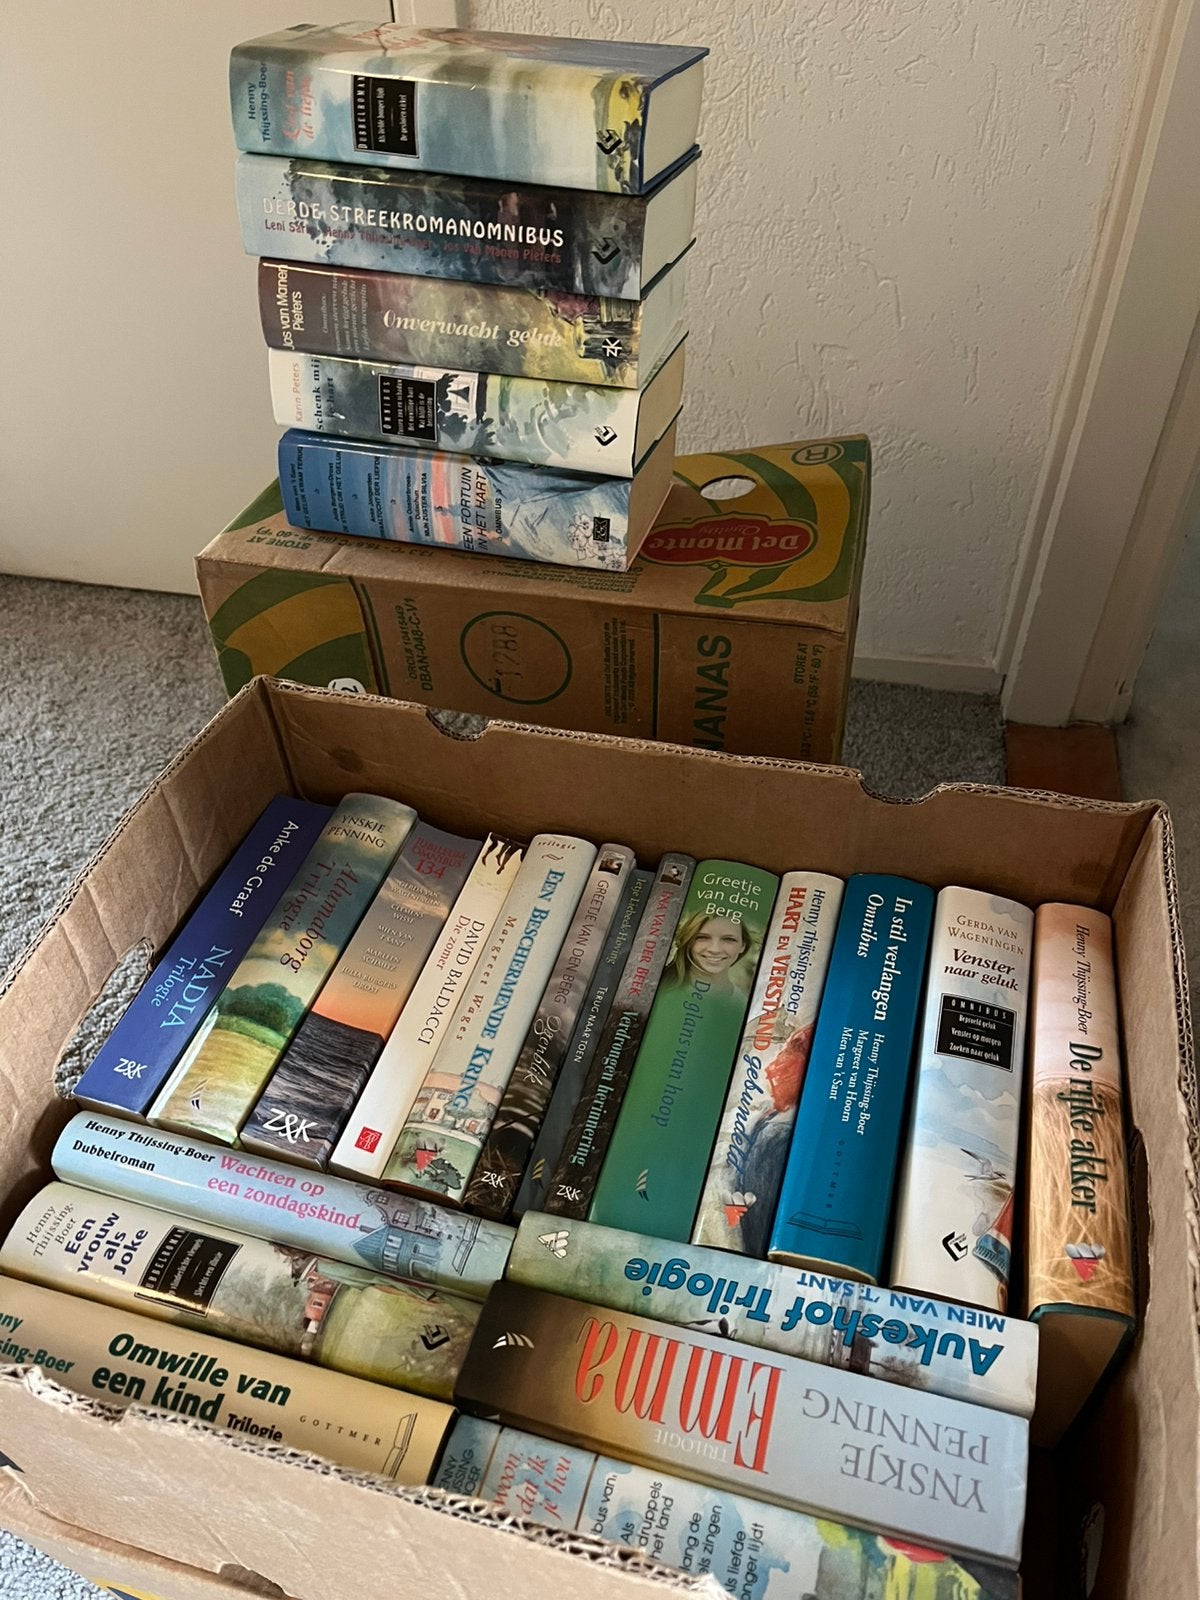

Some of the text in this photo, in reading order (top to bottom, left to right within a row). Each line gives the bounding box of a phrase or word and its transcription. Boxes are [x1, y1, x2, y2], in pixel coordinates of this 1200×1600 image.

[247, 82, 256, 120] Henny
[259, 62, 272, 143] Thijssing-Boer
[357, 76, 369, 150] DUBBELROMAN
[262, 197, 566, 248] DERDE STREEKROMANOMNIBUS
[264, 218, 286, 232] Leni
[522, 248, 562, 264] Pieters
[276, 264, 296, 351] Jos van Manen
[292, 290, 305, 332] Pieters
[383, 309, 564, 347] Onverwacht geluk
[292, 363, 303, 423] Karin Peters
[310, 359, 324, 430] Schenk mij
[382, 381, 393, 431] OMNIBUS
[420, 472, 430, 522] ZUSTER SILVIA
[460, 466, 474, 551] EEN FORTUIN
[474, 472, 489, 550] IN HET HART
[493, 498, 503, 535] OMNIBUS
[246, 536, 312, 551] STORE AT
[649, 534, 802, 552] Del Monte
[793, 642, 809, 685] STORE AT
[327, 826, 387, 849] PENNING
[341, 814, 387, 834] YNSKJE
[537, 840, 577, 851] trilogie
[228, 819, 300, 918] Anke de Graaf
[412, 845, 463, 868] OMNIBUS
[415, 858, 446, 880] 134
[281, 859, 338, 932] Trilogie
[696, 888, 760, 911] van den
[702, 872, 762, 897] Greetje
[279, 860, 359, 974] Adumaborg
[704, 902, 744, 924] Berg
[856, 892, 885, 959] Omnibus
[956, 913, 1019, 941] GERDA VAN
[435, 914, 472, 971] Die zomer
[554, 879, 610, 1005] GREETJE VAN DEN BERG
[628, 889, 674, 997] INA VAN DER BEEK
[786, 888, 826, 1016] Henny Thijssing-Boer
[870, 895, 913, 1022] In stil verlangen
[947, 925, 1025, 957] WAGENINGEN
[952, 948, 1016, 976] Venster
[149, 956, 198, 1009] Trilogie
[159, 944, 233, 1030] NADIA
[417, 919, 486, 1046] DAVID BALDACCI
[451, 867, 566, 1112] EEN BESCHERMENDE KRING
[456, 915, 518, 1041] Margreet Wages
[752, 886, 807, 1052] HART EN VERSTAND
[943, 964, 1019, 992] naar geluk
[1071, 923, 1093, 1036] Henny Thijssing-Boer
[573, 985, 609, 1063] TERUG NAAR TOEN
[951, 998, 1008, 1020] OMNIBUS
[113, 1056, 148, 1080] Z&K
[523, 1014, 562, 1087] Ogenblik
[651, 979, 711, 1129] De glans van hoop
[828, 1026, 854, 1101] Mien van Sant
[841, 1029, 870, 1123] Margreet van Hoorn
[569, 1010, 639, 1168] Verdrongen herinnering
[856, 1032, 886, 1136] Henny Thijssing-Boer
[262, 1107, 319, 1145] Z&K
[726, 1053, 764, 1175] gebundeld
[1056, 1040, 1109, 1215] De rijke akker
[72, 1138, 157, 1173] Dubbelroman
[84, 1119, 216, 1164] Henny Thijssing-Boer
[219, 1154, 325, 1198] Wachten op
[480, 1170, 506, 1188] Z&K
[556, 1184, 582, 1201] Z&K
[25, 1204, 57, 1246] Henny
[206, 1175, 362, 1230] een zondagskind
[32, 1202, 75, 1259] Thijssing-
[54, 1217, 77, 1247] Boer
[63, 1217, 97, 1256] Een
[76, 1210, 121, 1274] vrouw
[102, 1230, 127, 1262] als
[113, 1228, 150, 1277] Joke
[623, 1257, 1005, 1378] Aukeshof Trilogie
[796, 1271, 1007, 1334] MIEN VAN SANT
[90, 1364, 226, 1424] een kind
[108, 1331, 293, 1408] Omwille van
[574, 1315, 788, 1476] Emma
[298, 1414, 384, 1447] GOTTMER
[652, 1426, 731, 1464] TRILOGIE
[801, 1386, 991, 1467] PENNING
[527, 1454, 549, 1476] ik
[544, 1455, 572, 1495] hou
[840, 1441, 990, 1515] YNSKJE
[620, 1521, 636, 1545] Als
[637, 1480, 664, 1548] druppels
[650, 1495, 675, 1561] het land
[688, 1511, 703, 1534] de
[703, 1504, 724, 1556] zingen
[727, 1530, 747, 1576] liefde
